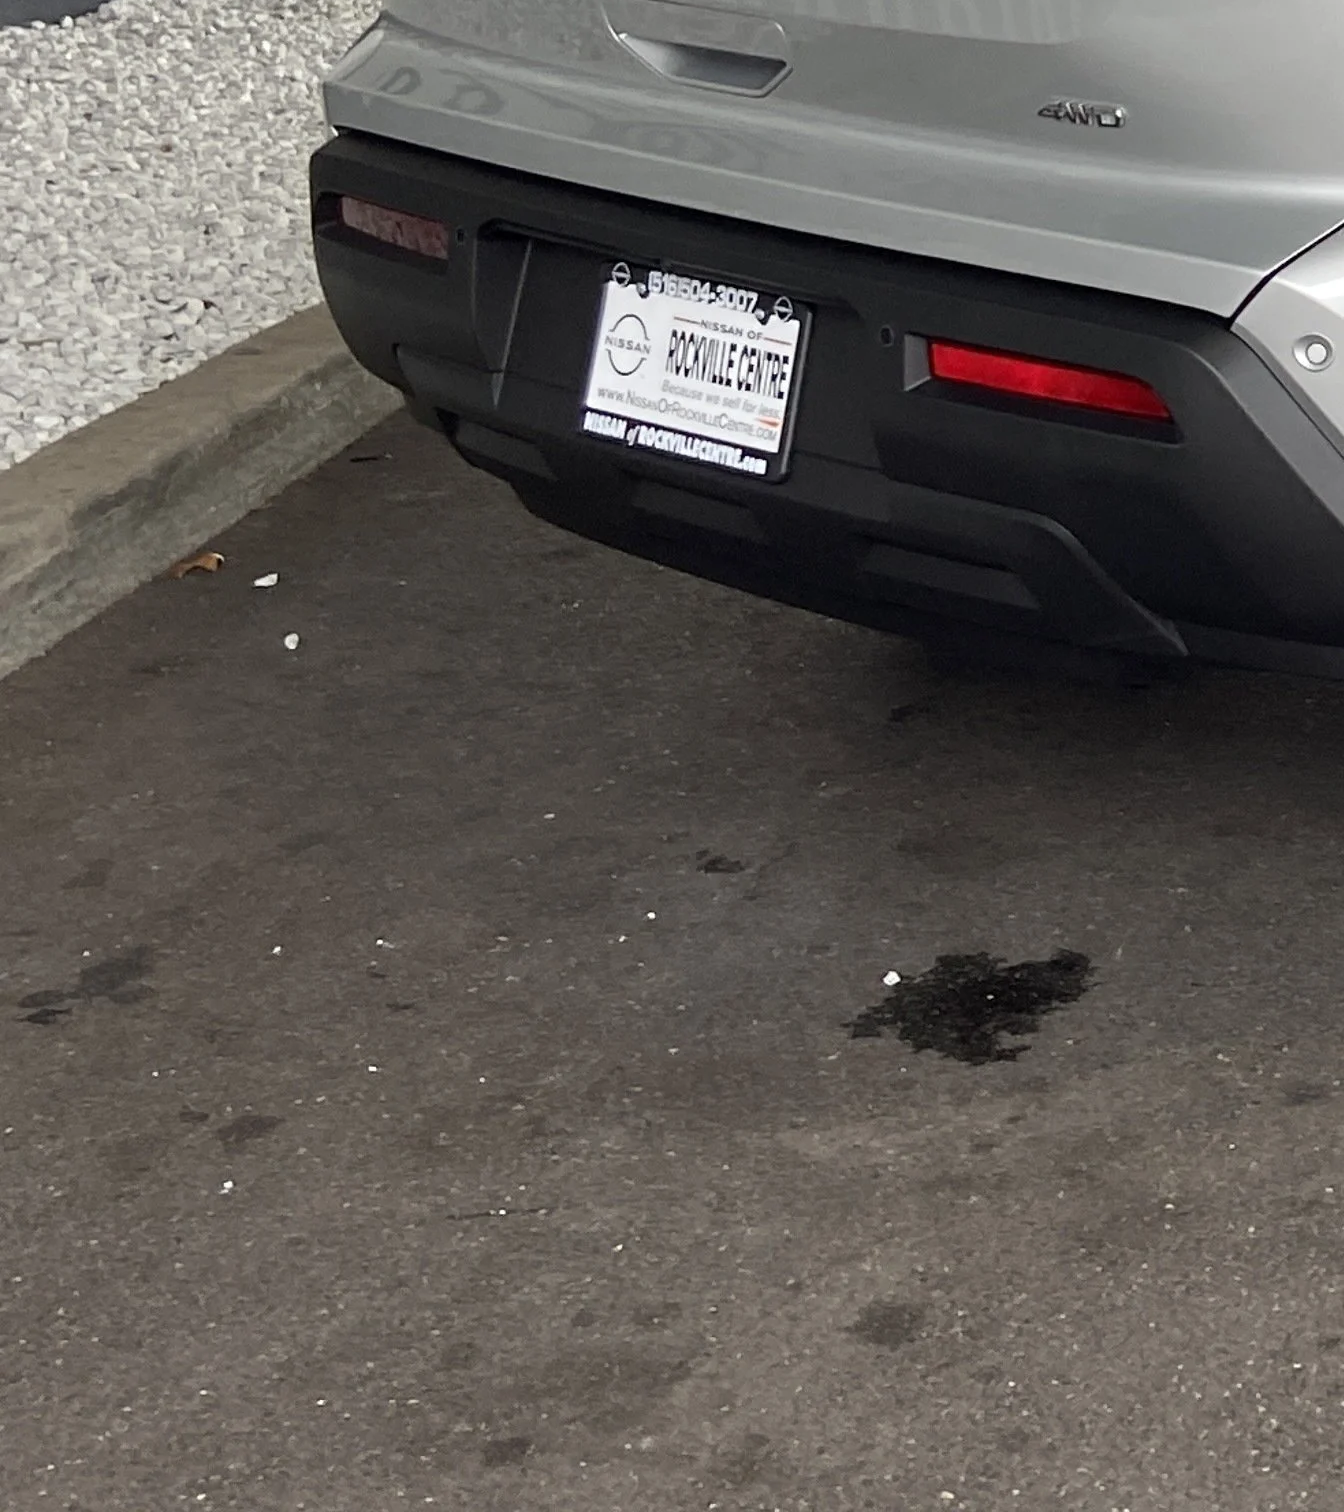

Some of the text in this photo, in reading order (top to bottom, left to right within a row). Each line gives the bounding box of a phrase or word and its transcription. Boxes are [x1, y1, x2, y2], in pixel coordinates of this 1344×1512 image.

[1037, 99, 1127, 129] 4WD
[700, 319, 763, 340] NISSAN OF
[604, 336, 650, 355] NISSAN
[665, 329, 789, 399] ROCKVILLE CENTRE
[661, 379, 703, 401] Because
